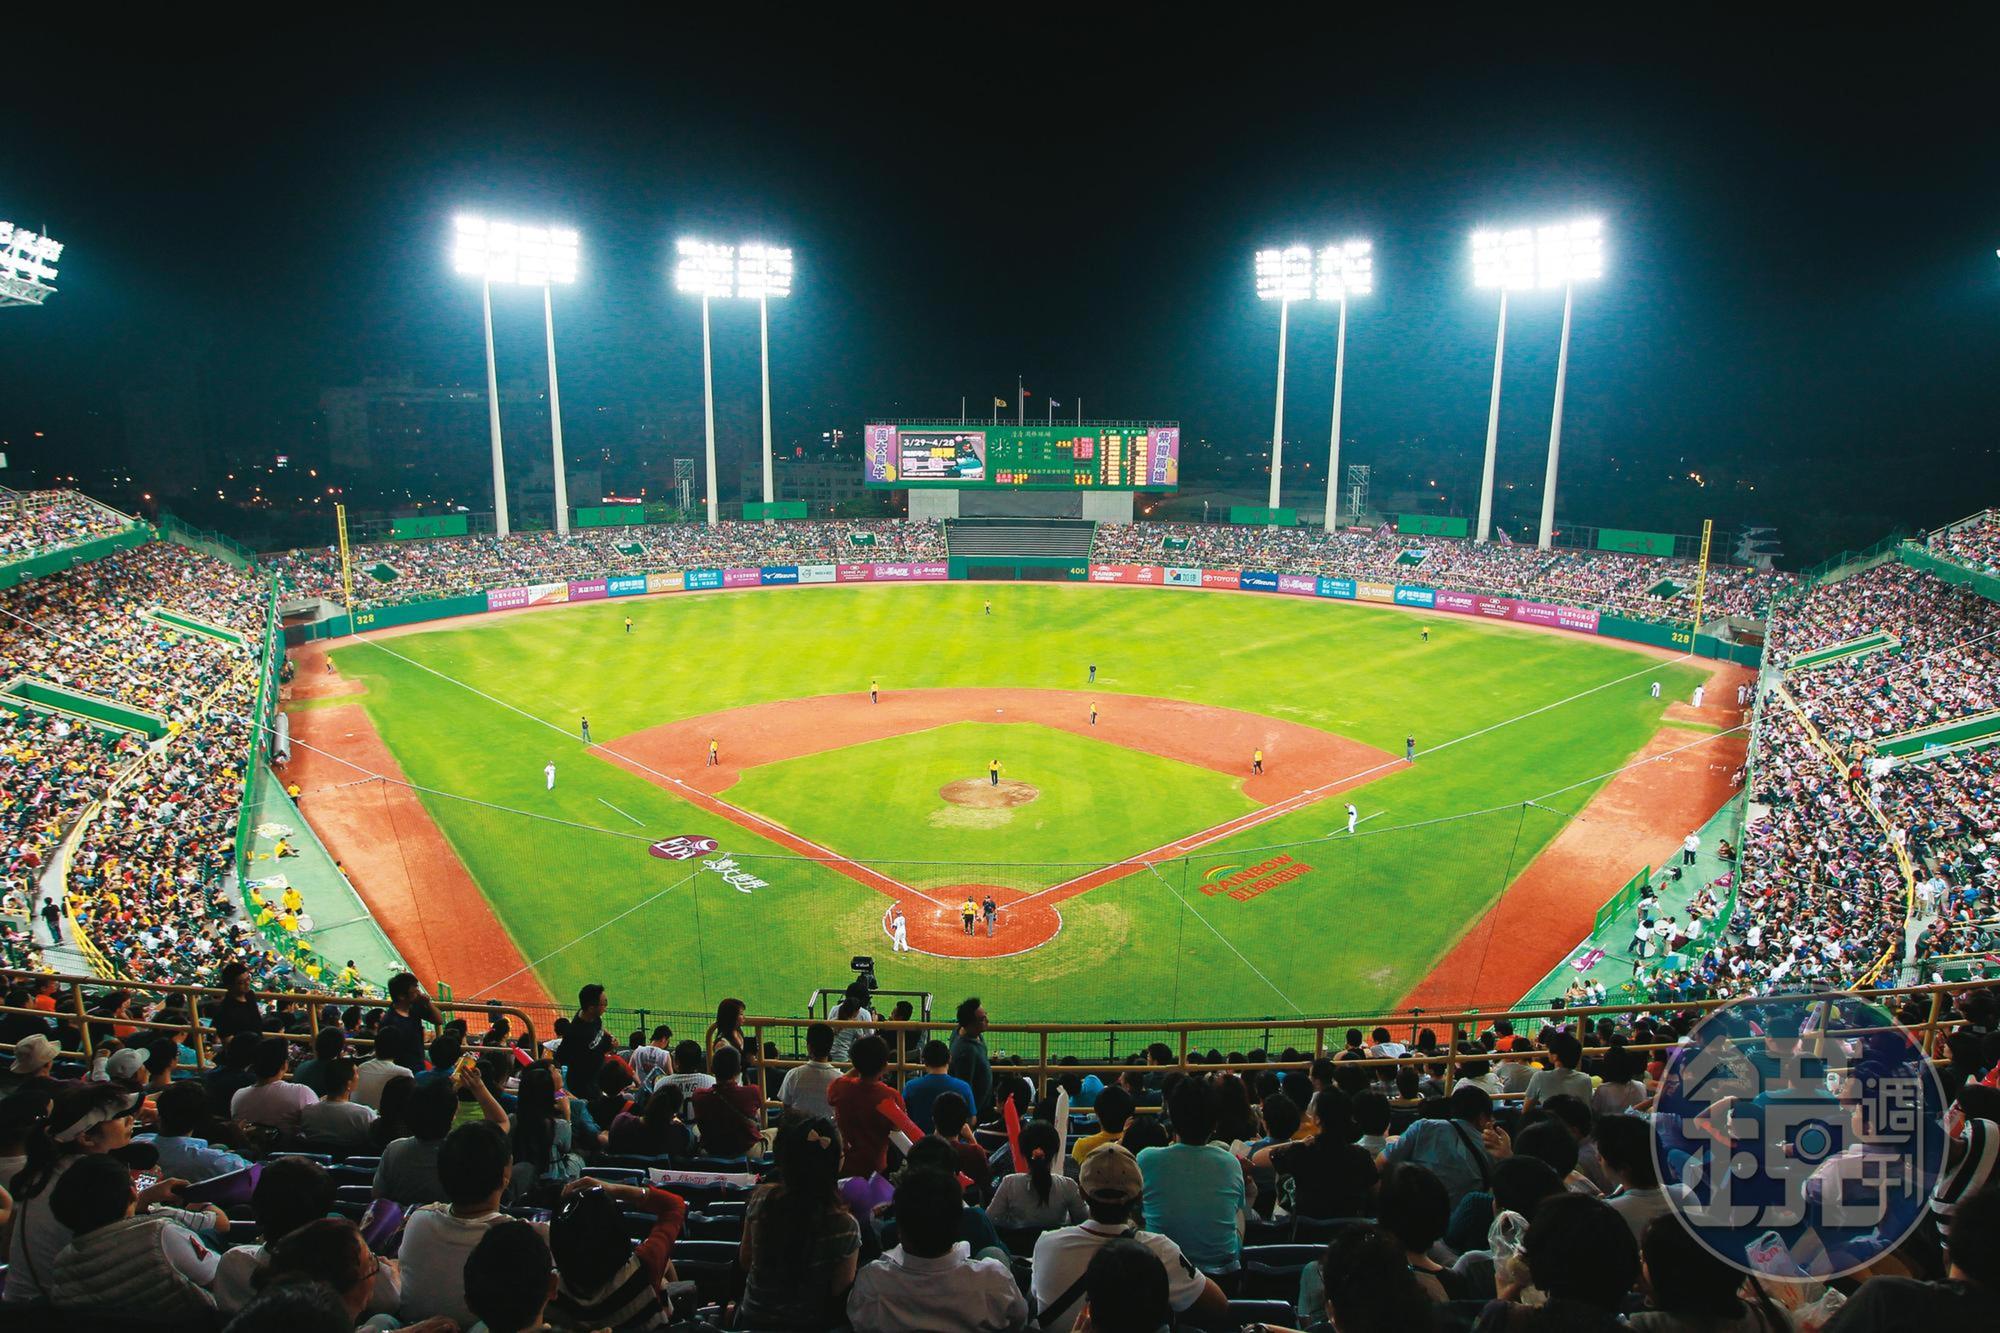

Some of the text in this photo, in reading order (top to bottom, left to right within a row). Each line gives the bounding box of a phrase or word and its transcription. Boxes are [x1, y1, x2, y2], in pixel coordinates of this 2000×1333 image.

[1070, 567, 1086, 575] 400
[1212, 575, 1239, 583] TOYOTA
[356, 613, 375, 625] 328
[1671, 631, 1690, 644] 328
[1199, 853, 1294, 897] RAINBOW
